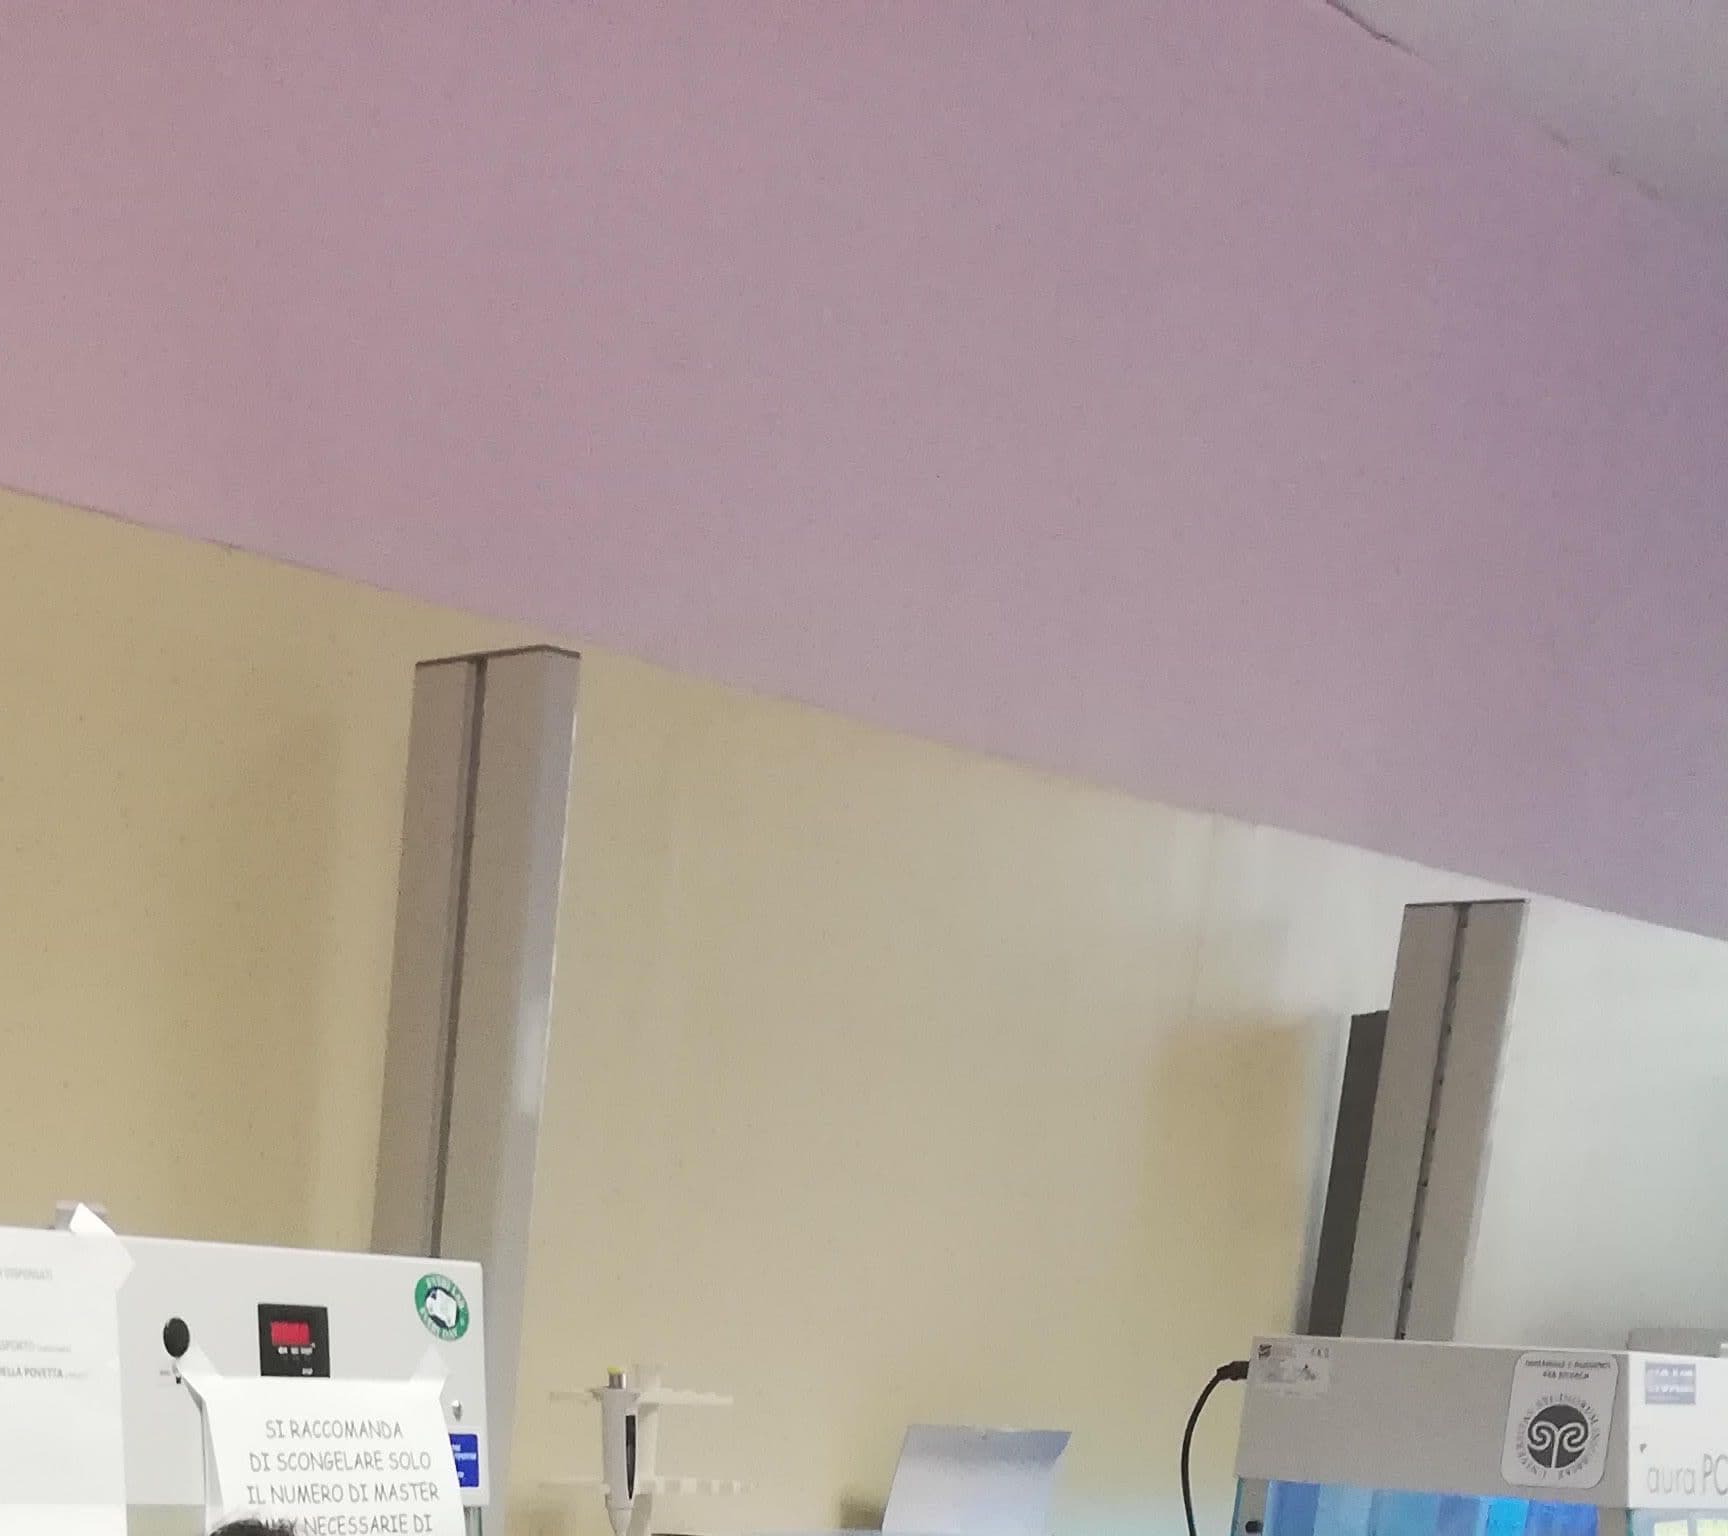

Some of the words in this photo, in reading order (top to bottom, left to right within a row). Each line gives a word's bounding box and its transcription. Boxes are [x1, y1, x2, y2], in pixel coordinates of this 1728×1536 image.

[265, 1419, 285, 1439] SI
[289, 1419, 404, 1440] RACCOMANDA
[249, 1452, 271, 1472] DI
[276, 1450, 384, 1472] SCONGELARE
[389, 1451, 432, 1472] SOLO
[1647, 1466, 1696, 1495] aura
[247, 1485, 266, 1505] IL
[270, 1483, 344, 1504] NUMERO
[349, 1483, 369, 1503] DI
[374, 1481, 441, 1502] MASTER
[303, 1513, 409, 1536] NECESSARIE
[414, 1514, 434, 1534] DI
